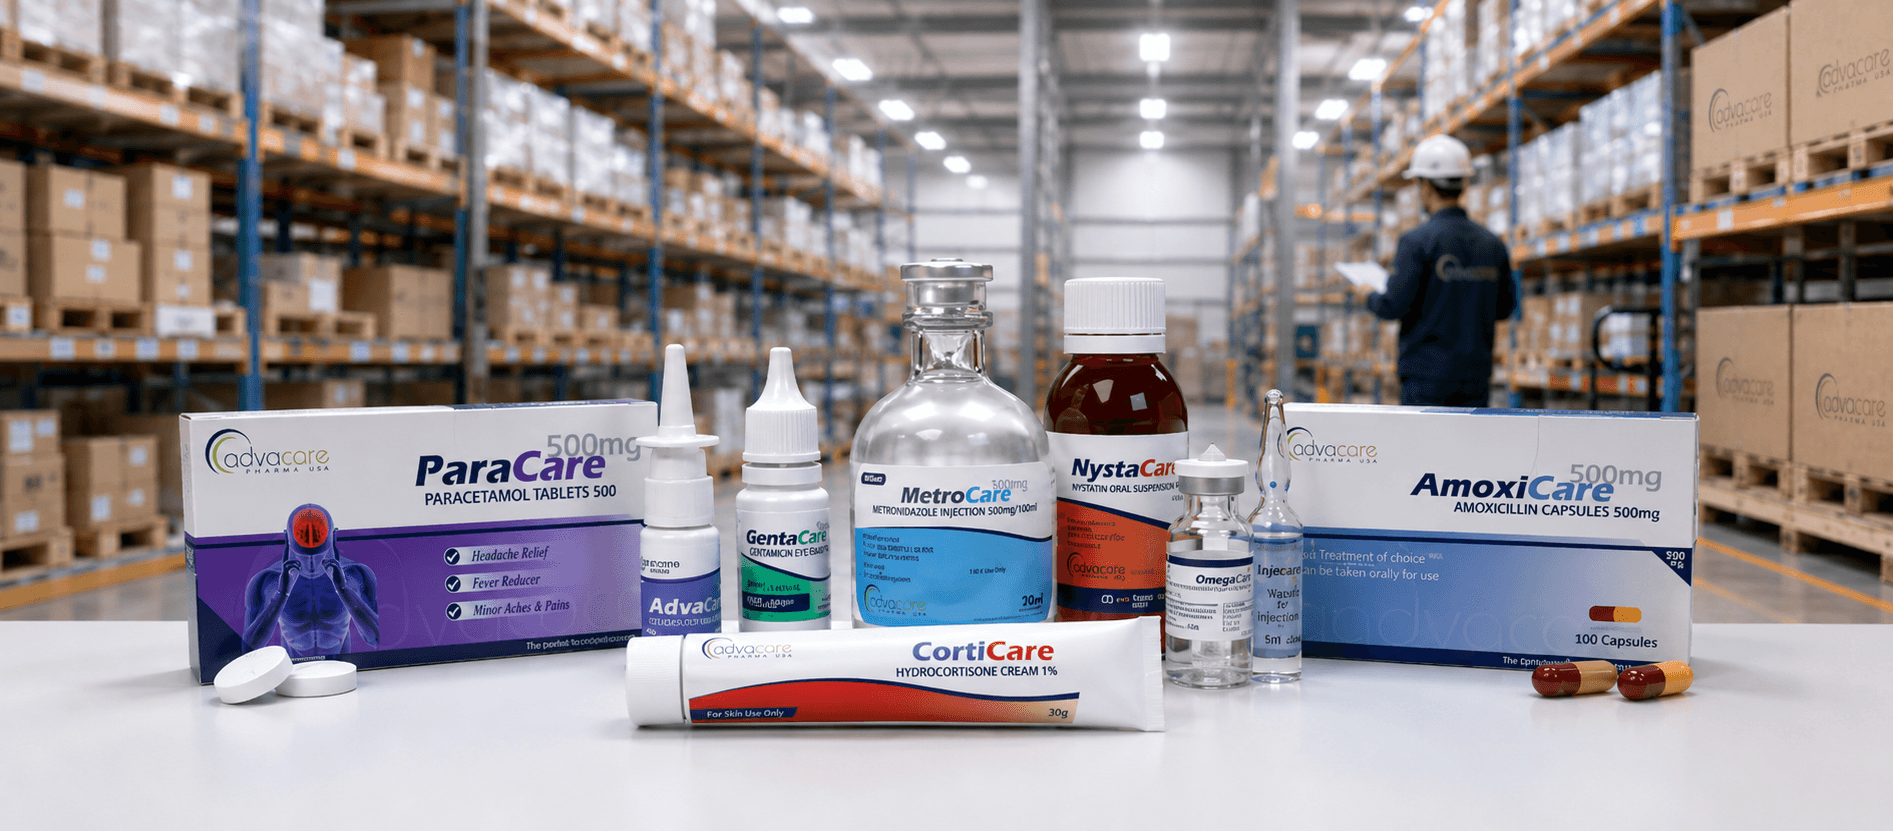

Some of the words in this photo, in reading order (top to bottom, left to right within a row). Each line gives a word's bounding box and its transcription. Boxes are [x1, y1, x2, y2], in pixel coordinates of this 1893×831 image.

[1824, 389, 1886, 418] advacare
[547, 432, 642, 462] 500mg
[1293, 439, 1377, 458] advacare
[224, 446, 330, 469] advacare
[245, 467, 299, 475] PHARMA
[415, 450, 606, 487] ParaCare
[1569, 464, 1662, 492] 500mg
[425, 488, 531, 506] PARACETAMOL
[533, 485, 590, 501] TABLETS
[593, 484, 617, 498] 500
[901, 486, 1012, 504] MetroCare
[1072, 483, 1106, 493] NYSTATIN
[1110, 484, 1132, 493] ORAL
[1133, 482, 1175, 493] SUSPENSION
[1410, 472, 1615, 502] AmoxiCare
[872, 505, 938, 518] METRONIDAZOLE
[940, 507, 986, 519] INJECTION
[988, 503, 1038, 517] 500mg/100ml
[1453, 501, 1538, 516] AMOXICILLIN
[1541, 503, 1610, 518] CAPSULES
[1613, 506, 1660, 522] 500mg
[746, 529, 827, 546] GentaCare
[472, 549, 519, 562] Headache
[522, 546, 550, 560] Relief
[1319, 549, 1374, 562] Treatment
[1376, 552, 1388, 563] of
[1390, 552, 1426, 564] choice
[1319, 564, 1333, 576] be
[1336, 566, 1366, 578] taken
[1369, 567, 1400, 582] orally
[1402, 568, 1418, 580] for
[1421, 571, 1440, 581] use
[472, 576, 500, 590] Fever
[502, 574, 541, 587] Reducer
[473, 603, 502, 617] Minor
[504, 601, 532, 614] Aches
[535, 600, 542, 612] &
[545, 599, 571, 612] Pains
[1257, 611, 1300, 625] injection
[714, 643, 792, 655] advacare
[1575, 633, 1598, 645] 100
[1601, 634, 1658, 650] Capsules
[912, 641, 1055, 662] CortiCare
[1502, 656, 1518, 665] The
[896, 666, 998, 678] HYDROCORTISONE
[1000, 666, 1038, 677] CREAM
[1042, 665, 1058, 676] 1%
[725, 710, 743, 718] Skin
[745, 710, 762, 718] Use
[764, 709, 784, 719] Only
[1048, 708, 1069, 719] 30g
